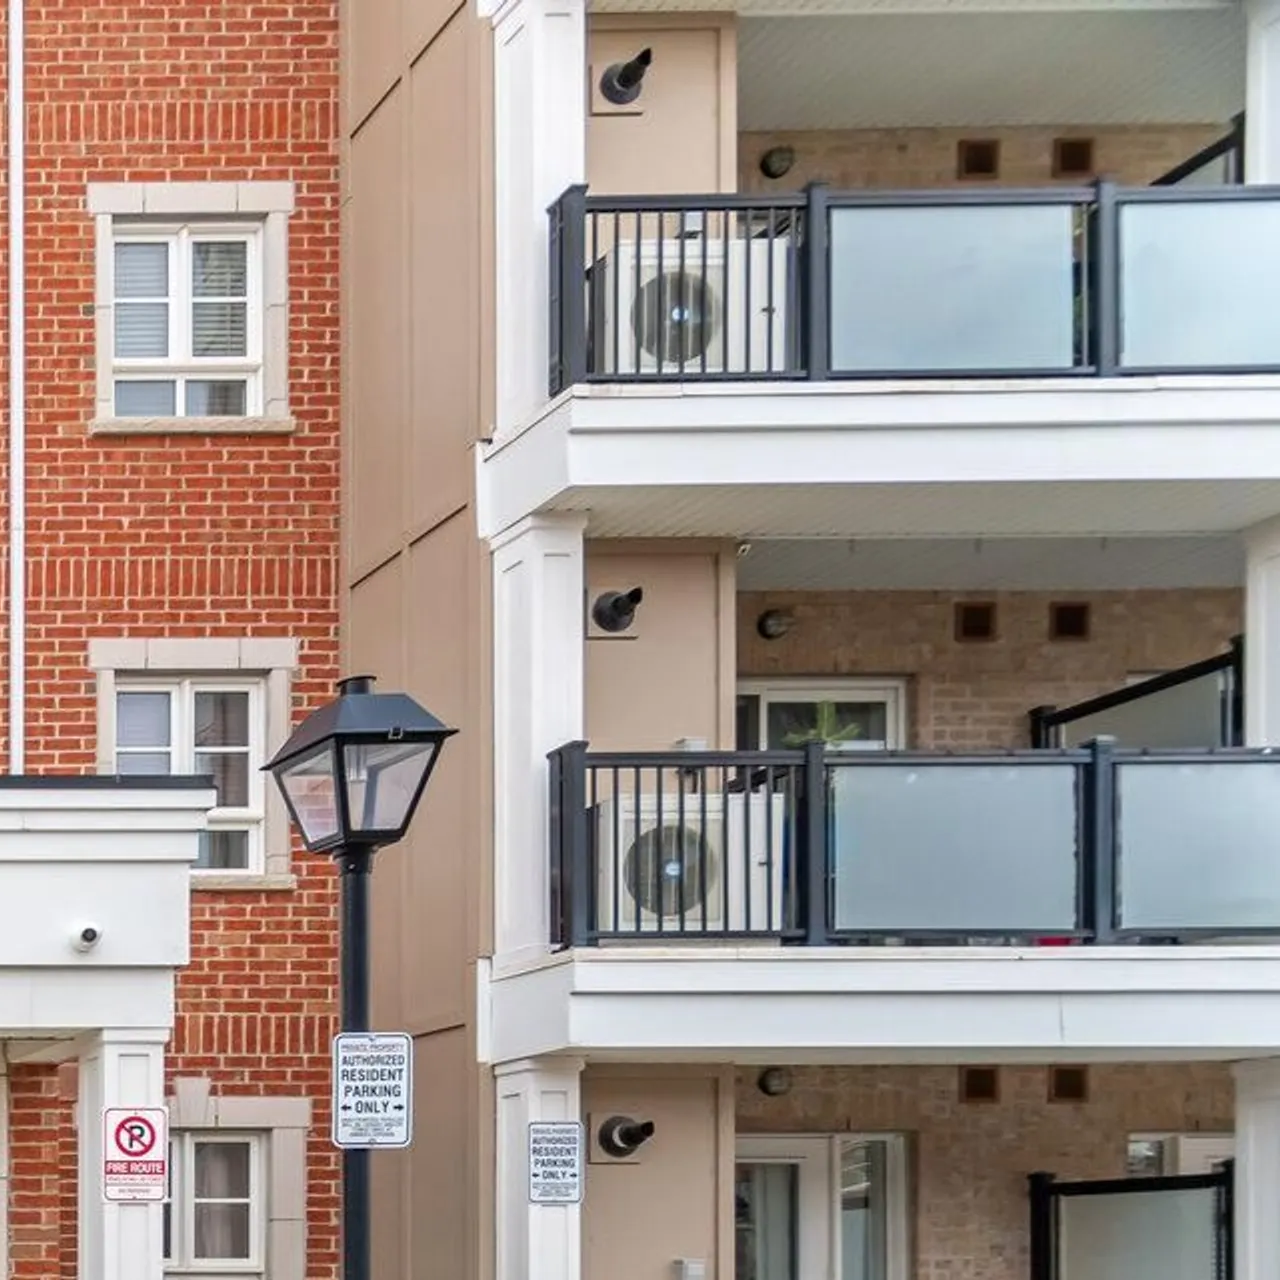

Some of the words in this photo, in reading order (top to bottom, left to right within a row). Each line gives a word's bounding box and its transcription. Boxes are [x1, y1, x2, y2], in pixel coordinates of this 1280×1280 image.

[342, 1054, 405, 1066] AUTHORIZED
[341, 1069, 404, 1081] RESIDENT
[344, 1084, 401, 1097] PARKING
[355, 1101, 389, 1113] ONLY
[532, 1147, 577, 1157] RESIDENT
[106, 1162, 128, 1173] FIRE
[130, 1162, 163, 1173] ROUTE
[534, 1159, 575, 1168] PARKING
[542, 1170, 567, 1179] ONLY
